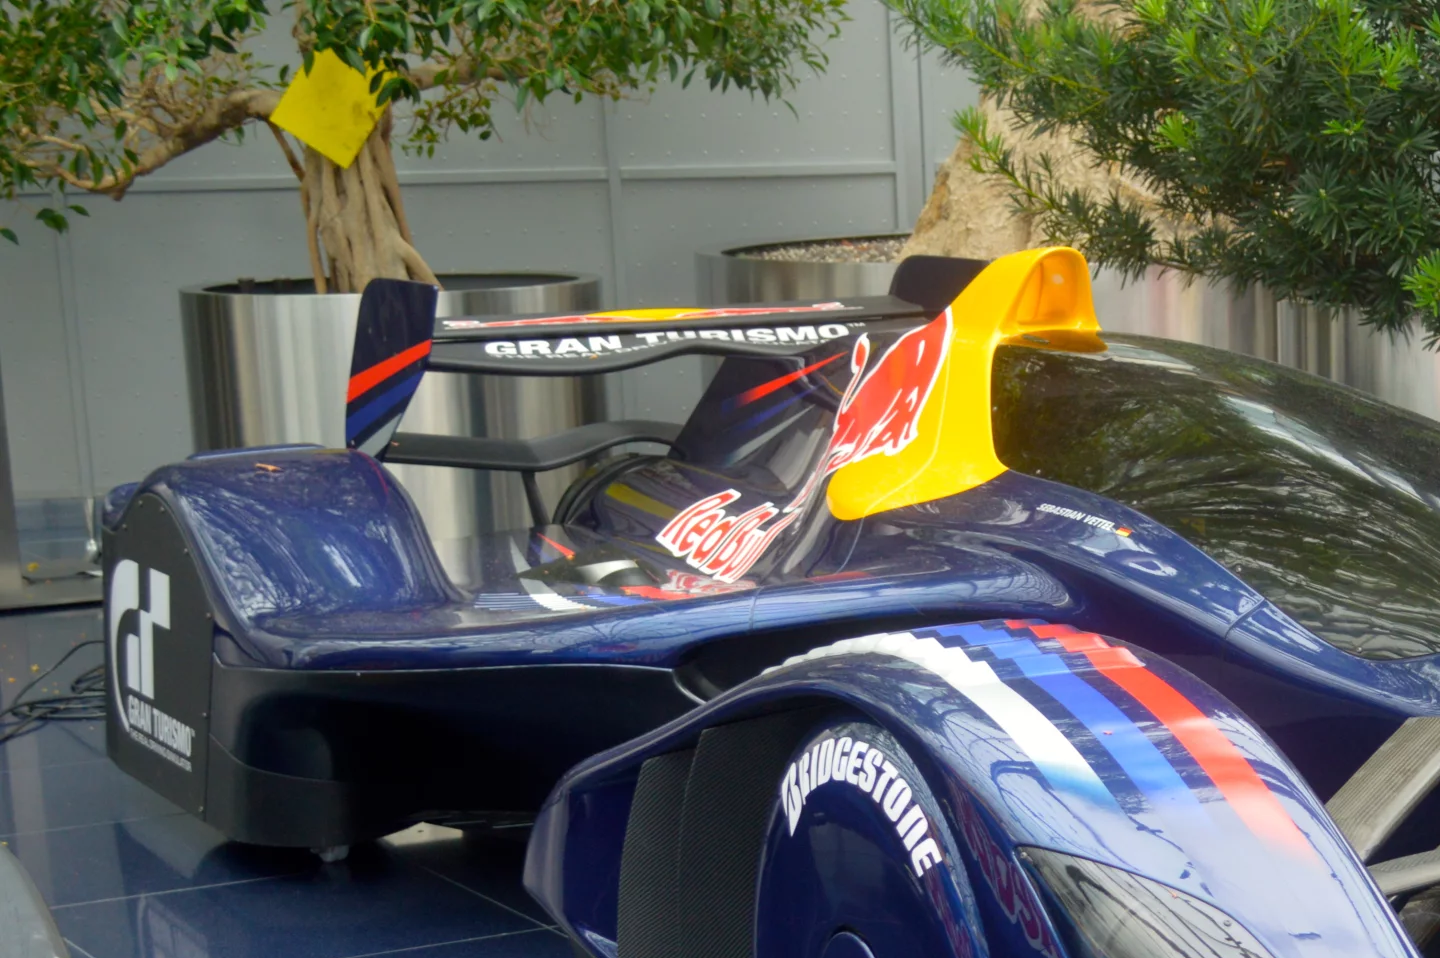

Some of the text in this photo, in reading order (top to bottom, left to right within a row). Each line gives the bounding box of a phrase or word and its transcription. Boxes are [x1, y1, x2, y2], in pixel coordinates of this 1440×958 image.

[485, 335, 623, 355] GRAN
[1036, 503, 1117, 531] SEBASTIAN VETTEL
[128, 694, 152, 736] GRAN
[781, 736, 943, 878] BRIDGESTONE
